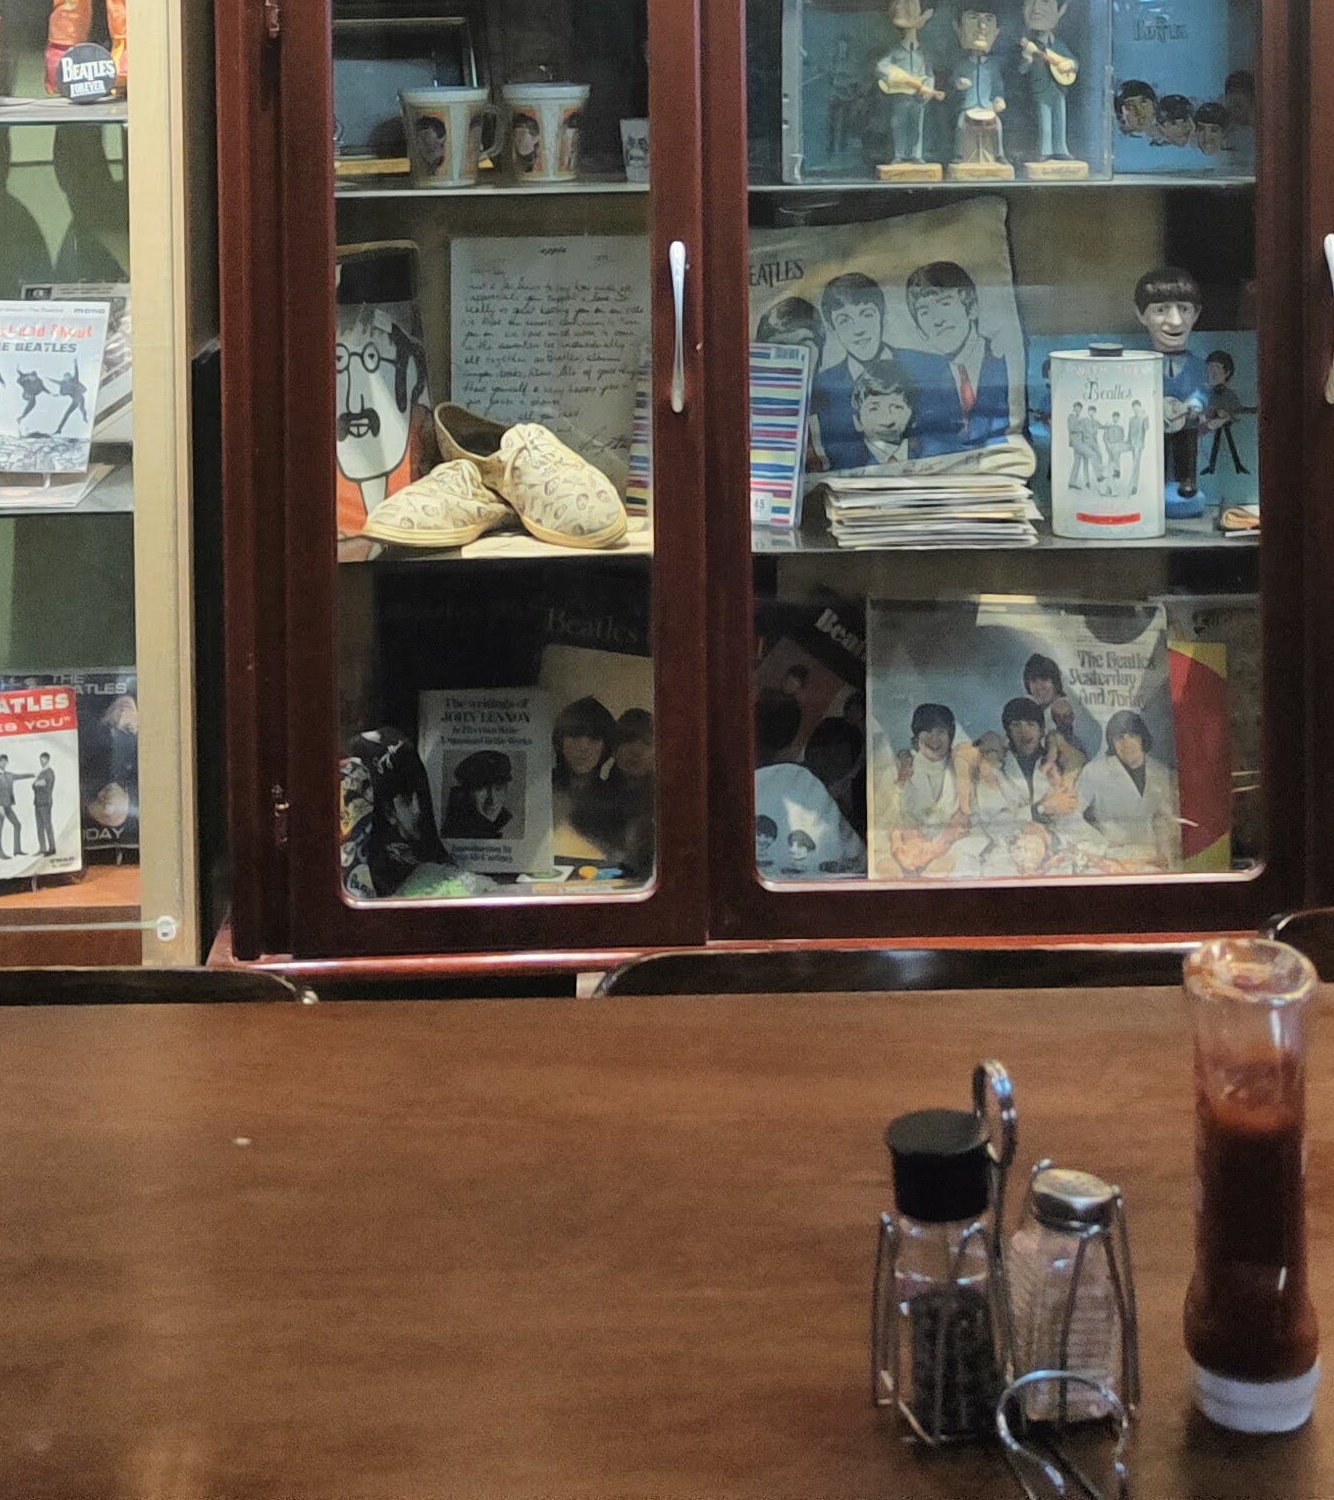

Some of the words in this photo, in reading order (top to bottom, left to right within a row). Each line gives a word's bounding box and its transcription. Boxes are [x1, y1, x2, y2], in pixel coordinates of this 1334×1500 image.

[61, 57, 116, 83] BEATLES
[70, 80, 107, 98] FOREVER
[749, 258, 805, 288] EATLES
[14, 342, 78, 353] BEATLES
[1077, 650, 1104, 669] The
[75, 682, 127, 695] ATLES
